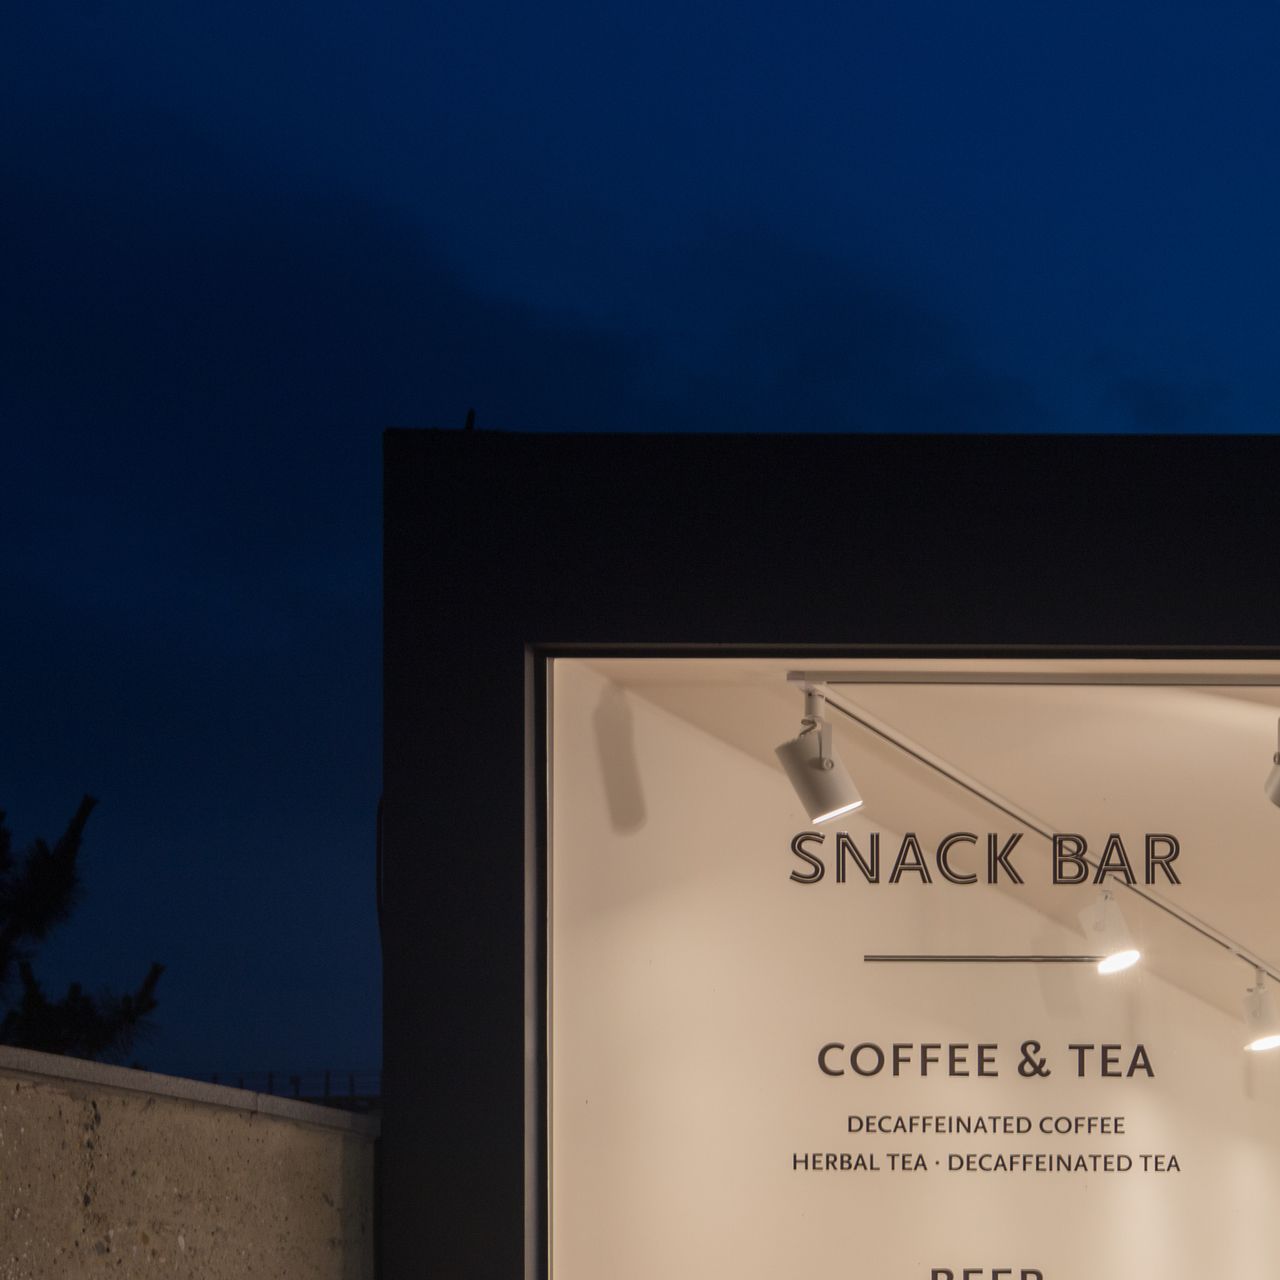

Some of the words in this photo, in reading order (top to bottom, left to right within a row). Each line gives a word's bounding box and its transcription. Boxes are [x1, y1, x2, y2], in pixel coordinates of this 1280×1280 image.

[790, 832, 1023, 885] SNACK
[1052, 832, 1181, 885] BAR
[818, 1042, 999, 1077] COFFEE
[1017, 1040, 1051, 1077] &
[1069, 1044, 1154, 1077] TEA
[848, 1116, 1032, 1134] DECAFFEINATED
[1039, 1117, 1125, 1134] COFFEE
[793, 1153, 879, 1171] HERBAL
[887, 1154, 928, 1171] TEA
[948, 1154, 1132, 1172] DECAFFEINATED
[1139, 1155, 1181, 1172] TEA
